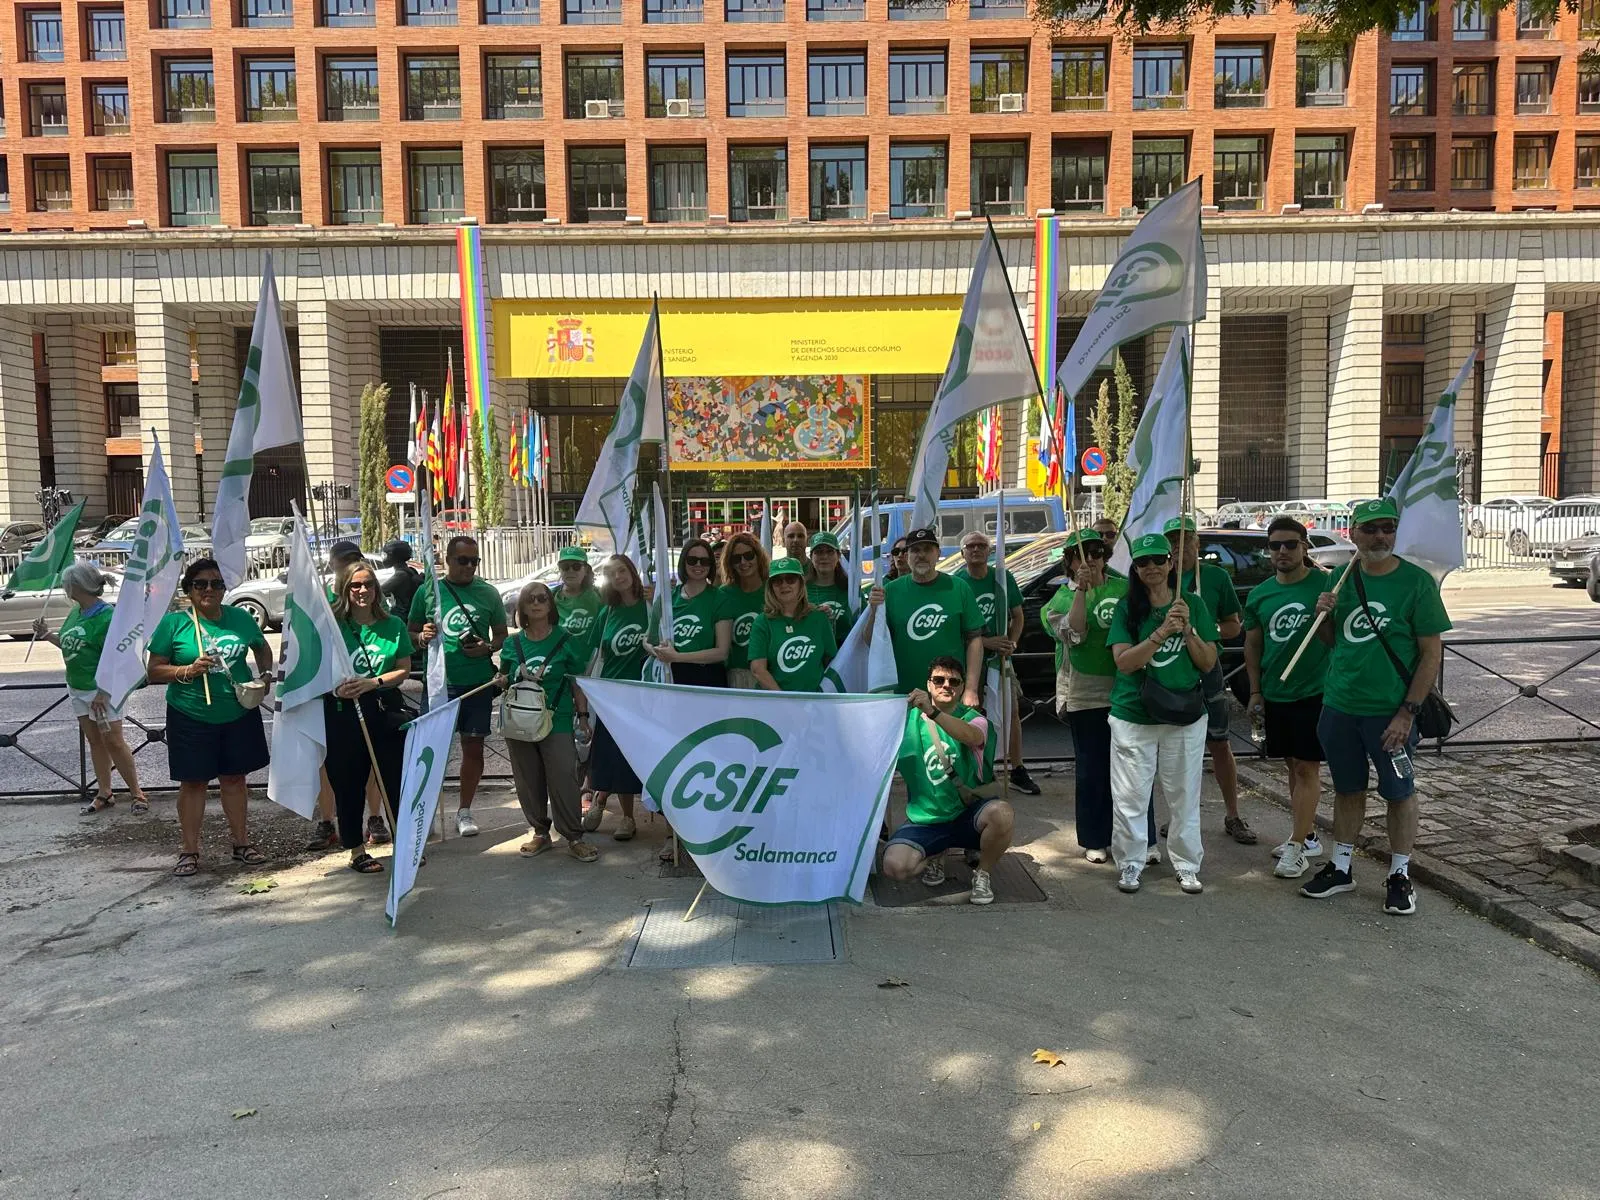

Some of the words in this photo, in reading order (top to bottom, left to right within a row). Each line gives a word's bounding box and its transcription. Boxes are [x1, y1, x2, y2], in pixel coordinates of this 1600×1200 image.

[915, 614, 949, 628] CSIF
[1276, 614, 1312, 629] CSIF
[673, 623, 704, 638] CSIF
[784, 645, 817, 661] CSIF
[671, 760, 800, 814] CSIF
[734, 842, 838, 865] Salamanca
